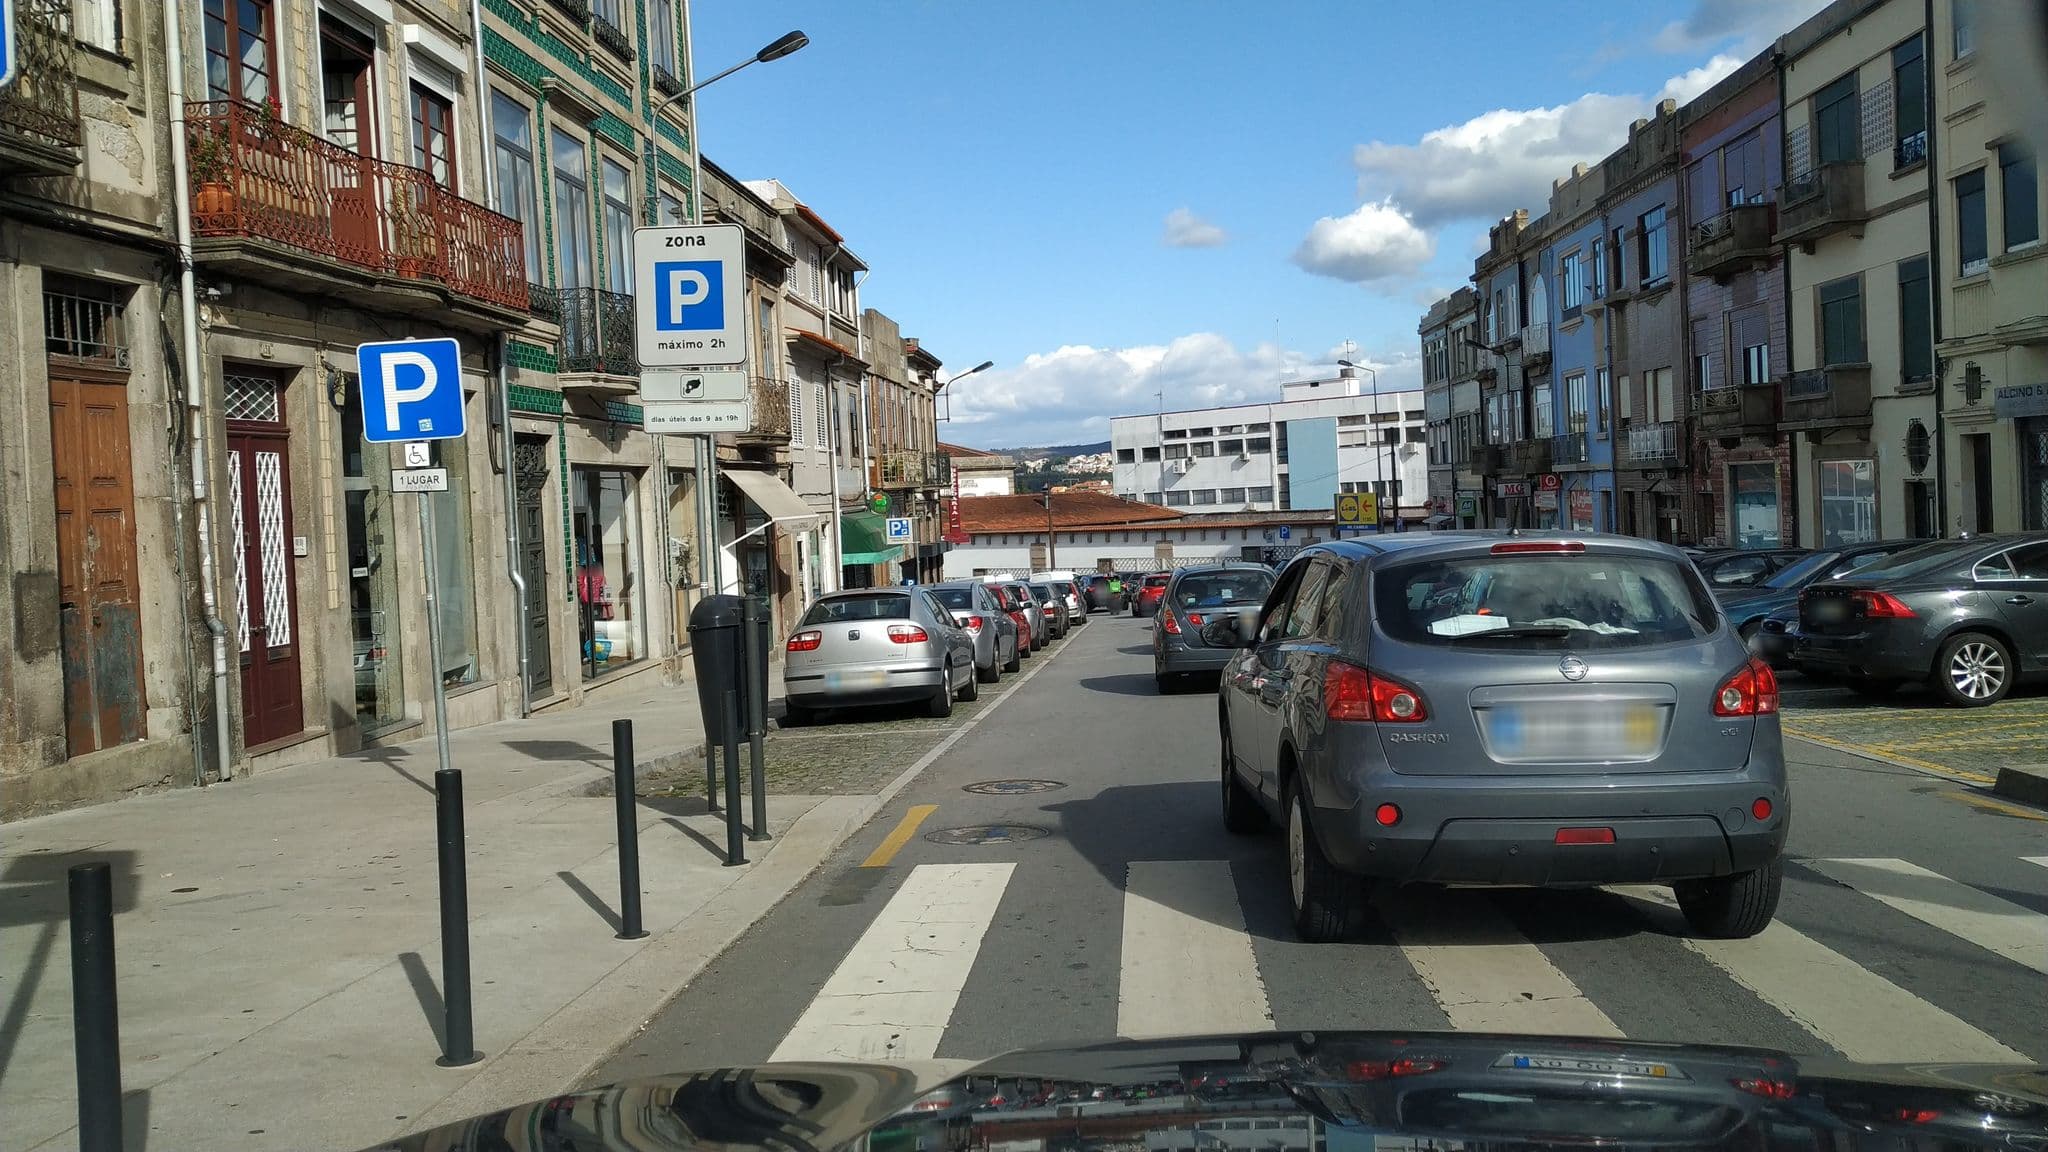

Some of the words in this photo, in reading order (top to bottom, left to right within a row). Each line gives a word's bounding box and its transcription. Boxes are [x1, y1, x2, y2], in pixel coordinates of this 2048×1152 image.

[665, 234, 706, 248] zona
[669, 270, 710, 324] P
[657, 338, 704, 351] máximo
[710, 337, 726, 350] 2h
[379, 351, 438, 432] P
[651, 415, 666, 424] dias
[669, 414, 686, 423] úteis
[690, 414, 702, 422] das
[705, 414, 711, 423] 9
[726, 413, 738, 422] 19h
[400, 476, 405, 485] 1
[406, 474, 440, 486] LUGAR
[891, 522, 902, 535] P
[1281, 527, 1288, 538] P
[1389, 732, 1450, 745] QASHQAI
